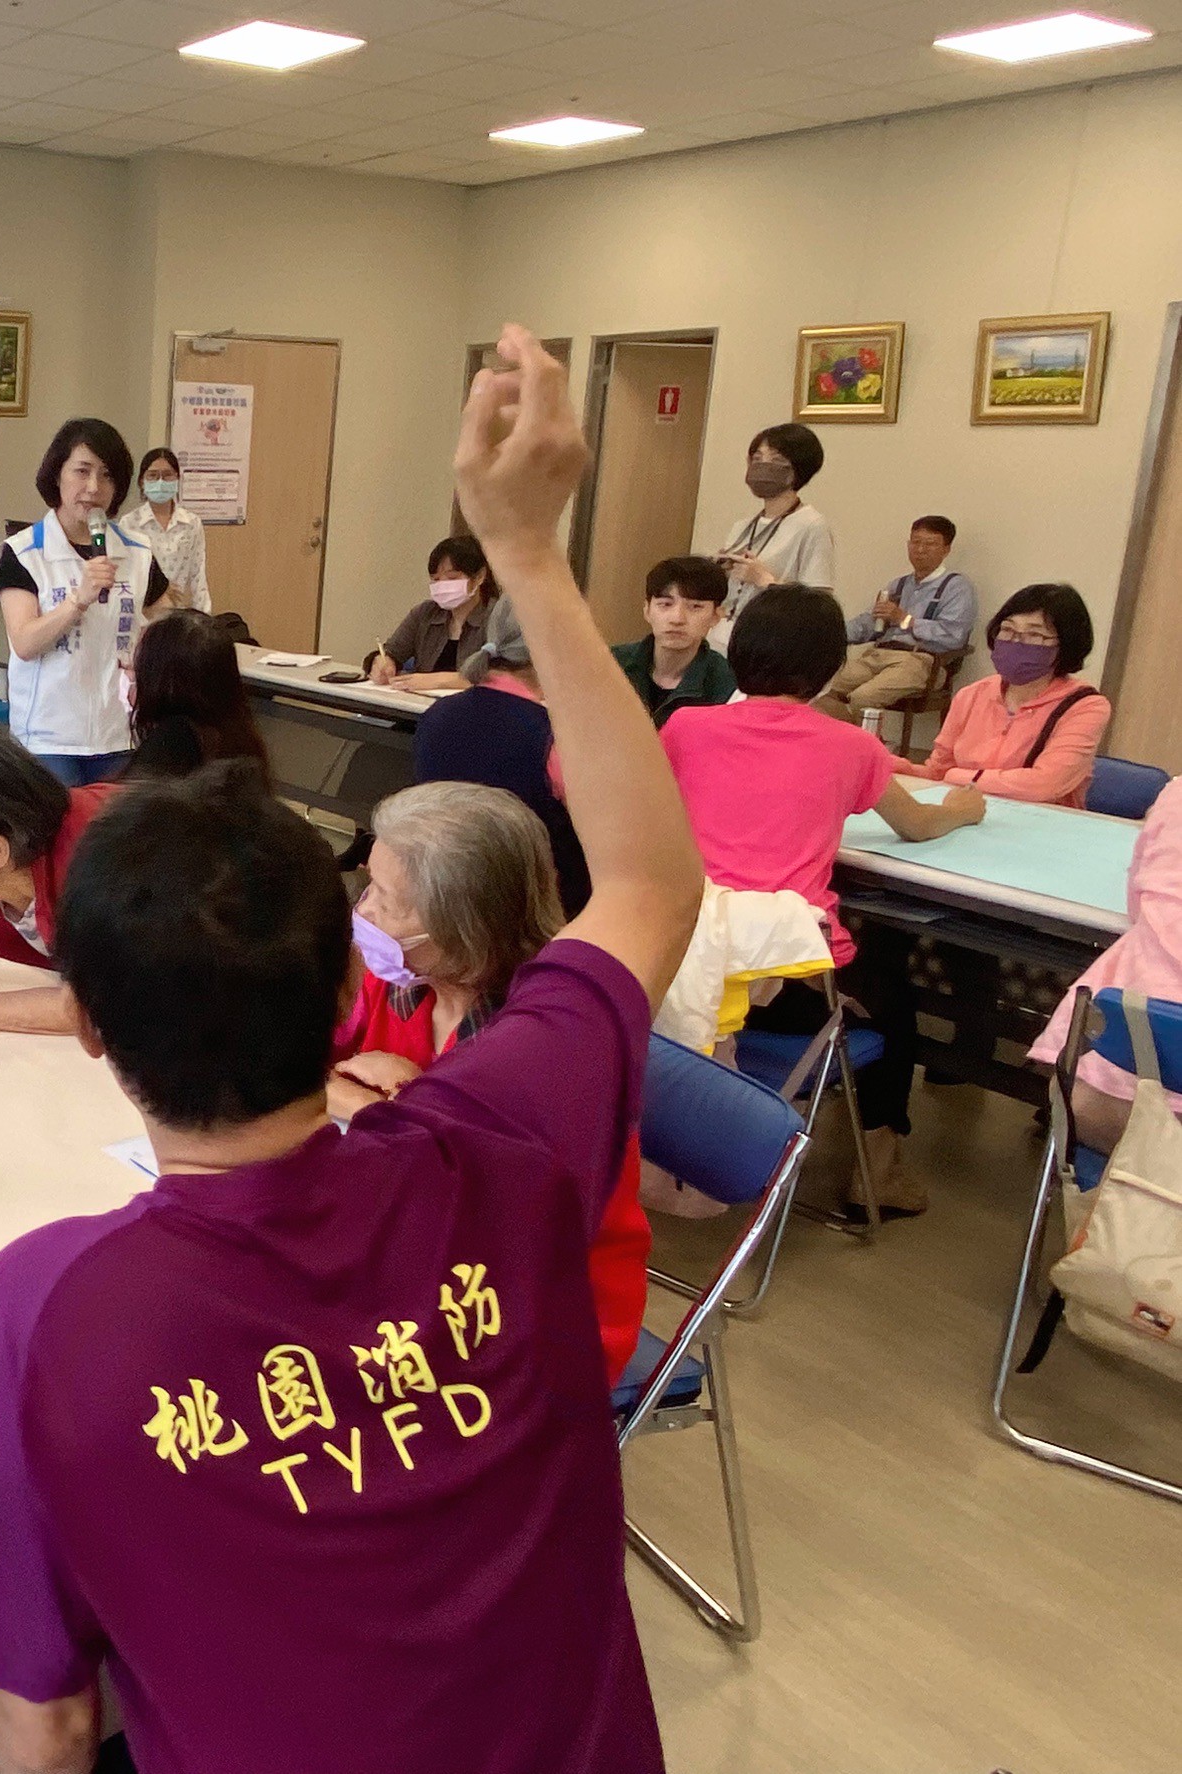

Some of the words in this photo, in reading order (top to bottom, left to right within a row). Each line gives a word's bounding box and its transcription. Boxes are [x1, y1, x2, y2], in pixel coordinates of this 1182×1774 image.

[142, 1263, 501, 1474] 桃園消防
[260, 1383, 492, 1514] TYFD
